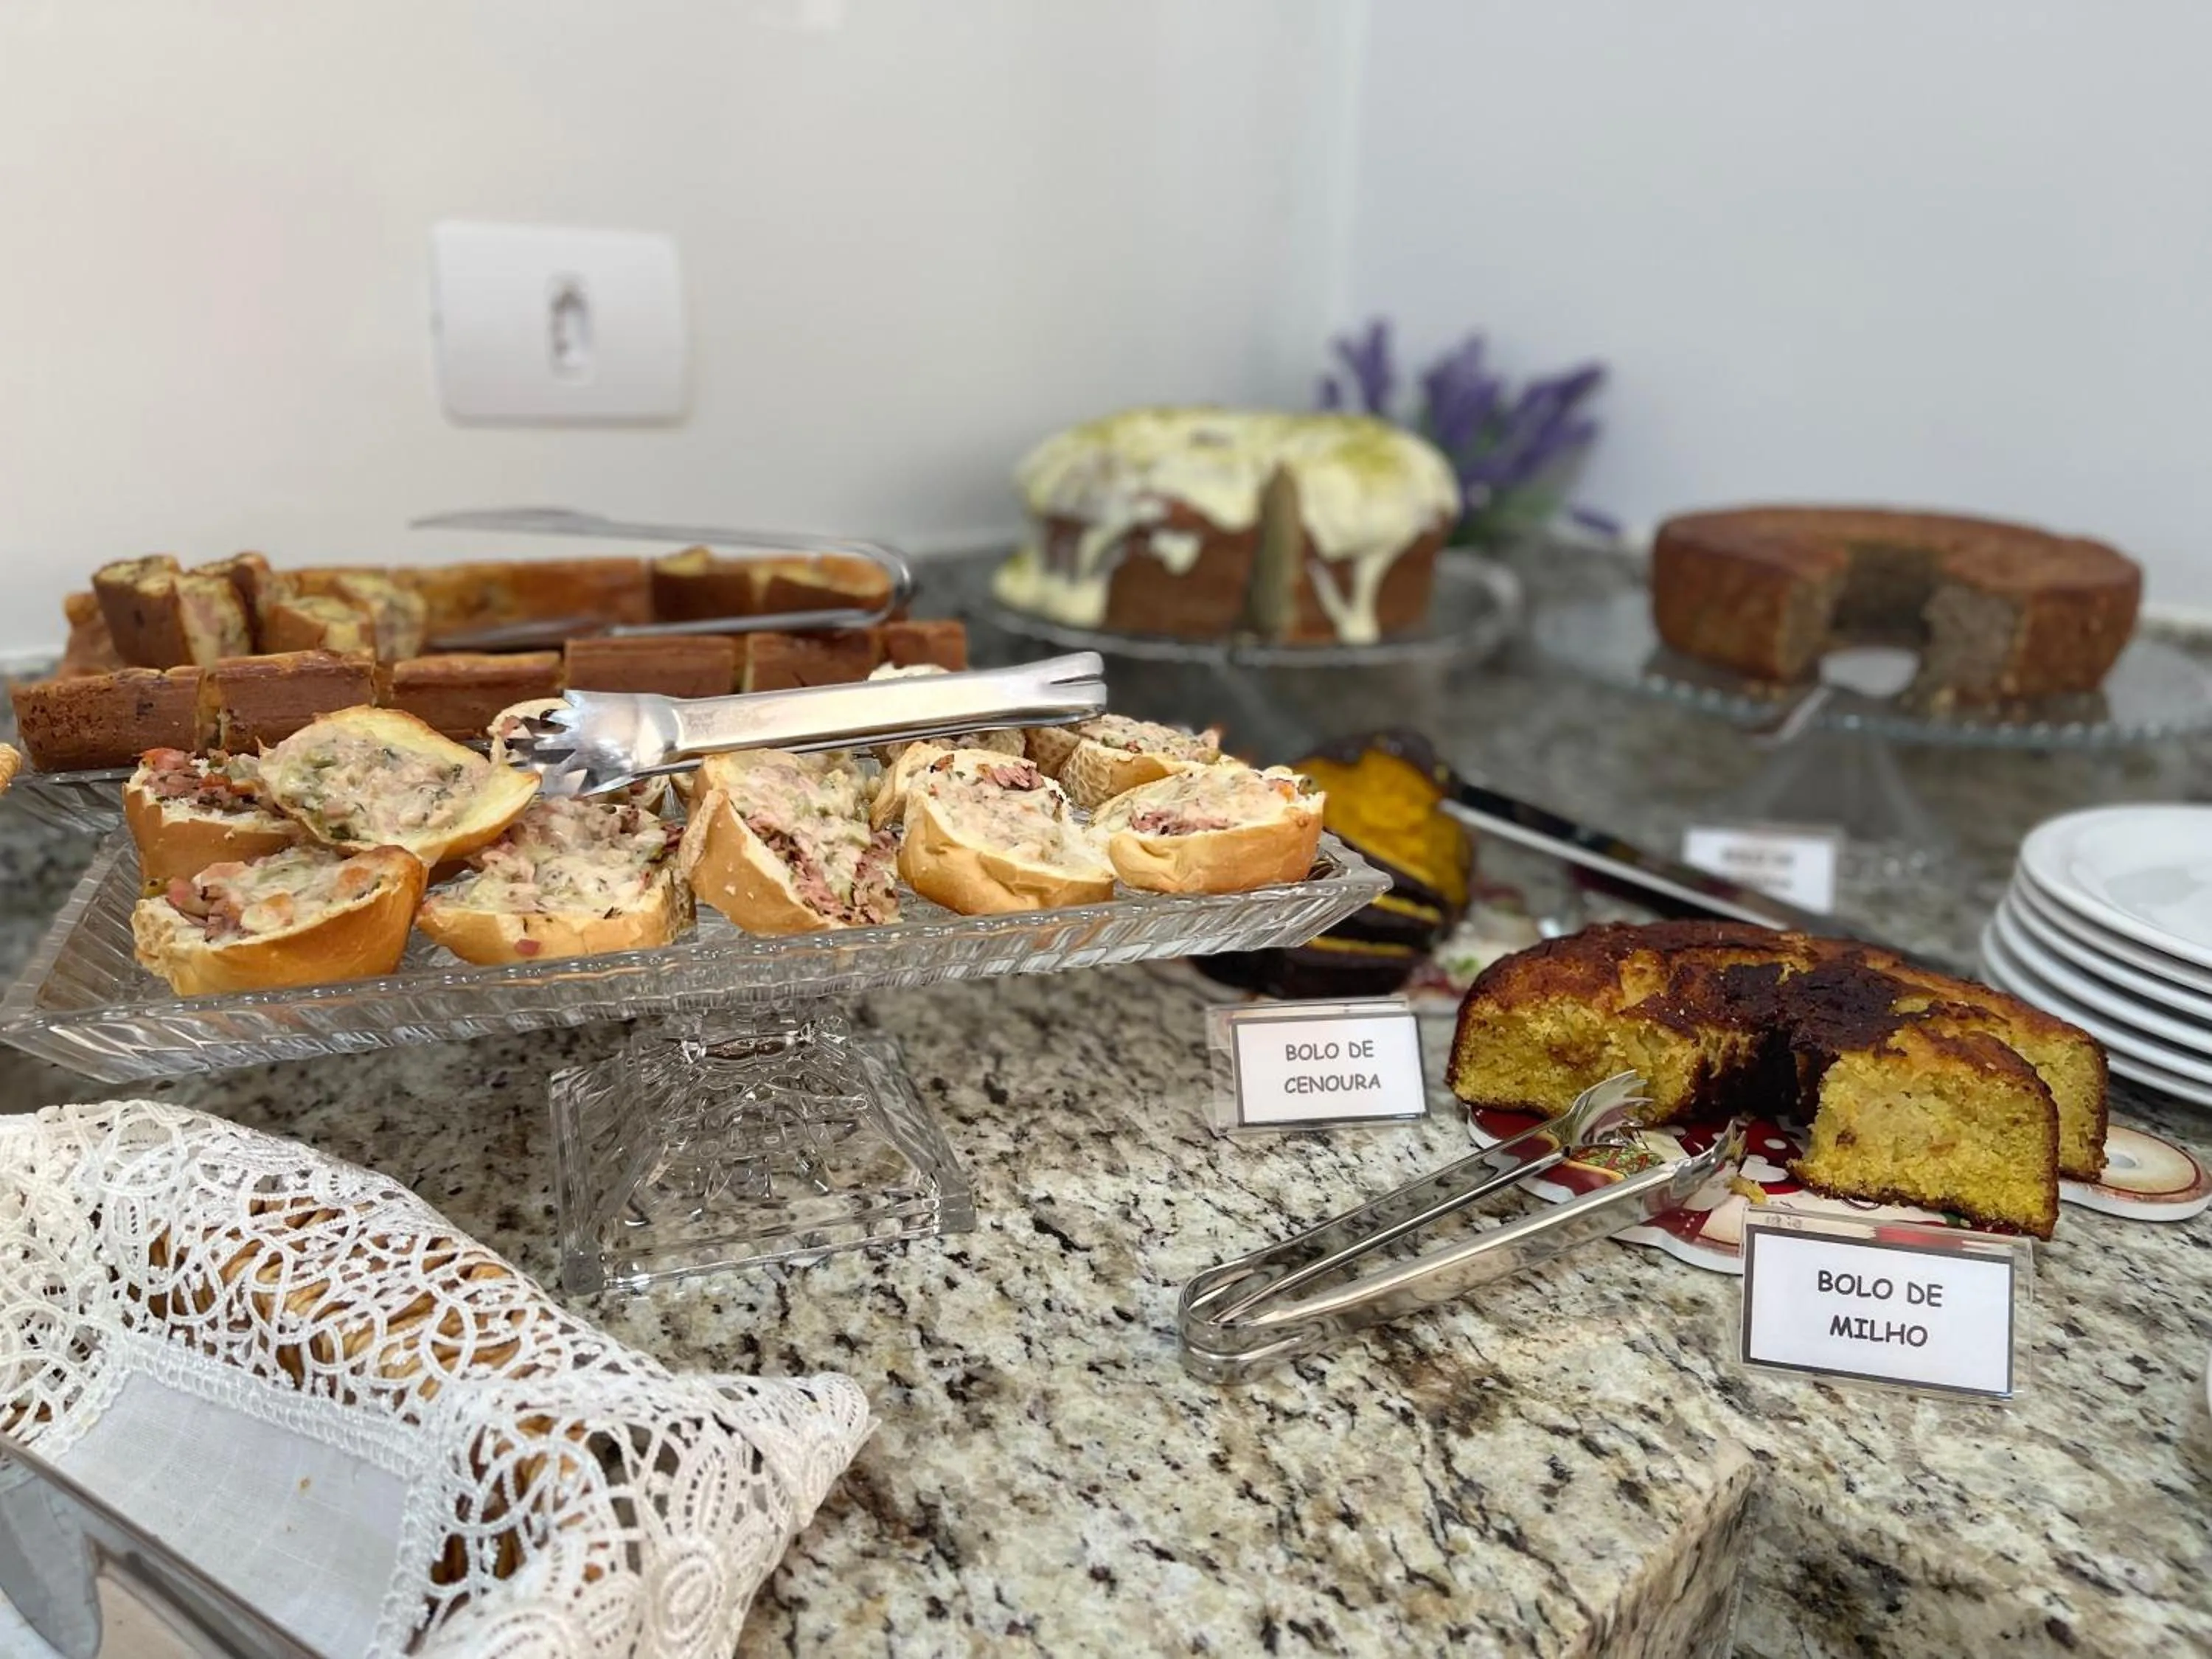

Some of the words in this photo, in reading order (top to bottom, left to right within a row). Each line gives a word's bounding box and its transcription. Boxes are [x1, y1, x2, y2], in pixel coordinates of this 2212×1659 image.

[1285, 1042, 1340, 1062] BOLO
[1348, 1040, 1374, 1059] DE
[1284, 1074, 1382, 1094] CENOURA
[1817, 1269, 1893, 1301] BOLO
[1907, 1281, 1944, 1308] DE
[1829, 1315, 1929, 1349] MILHO
